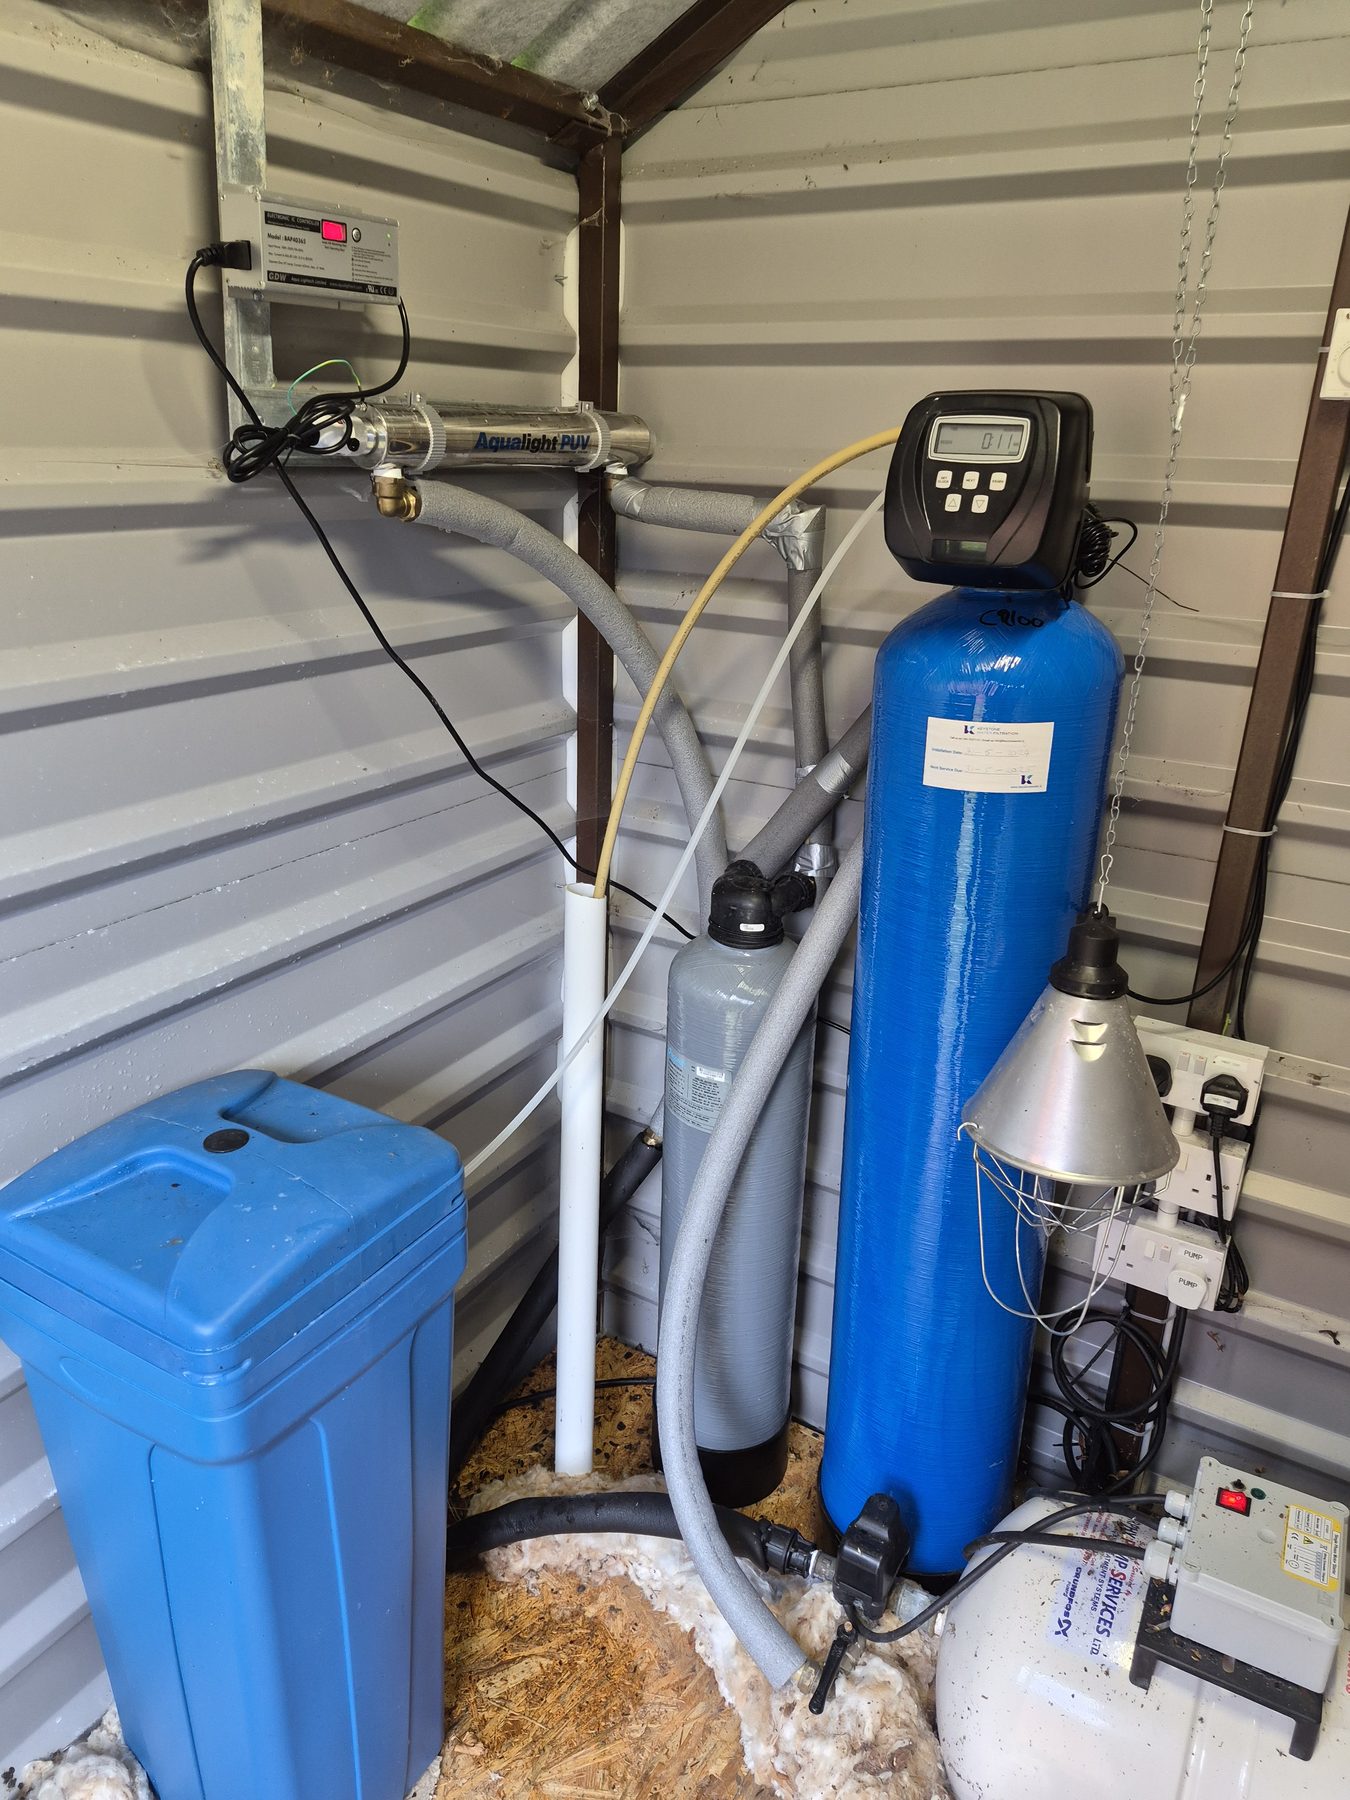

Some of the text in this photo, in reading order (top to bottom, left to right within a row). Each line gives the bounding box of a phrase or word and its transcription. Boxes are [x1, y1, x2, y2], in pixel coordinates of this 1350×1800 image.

[267, 232, 281, 240] Model
[268, 272, 286, 282] GDW
[475, 431, 591, 454] Aqualight PUV
[1183, 1249, 1204, 1261] PUMP
[1178, 1276, 1198, 1289] PUMP
[1063, 1566, 1082, 1618] GRUNDFOS
[1090, 1579, 1105, 1612] SYSTEMS
[1095, 1568, 1126, 1638] SERVICES
